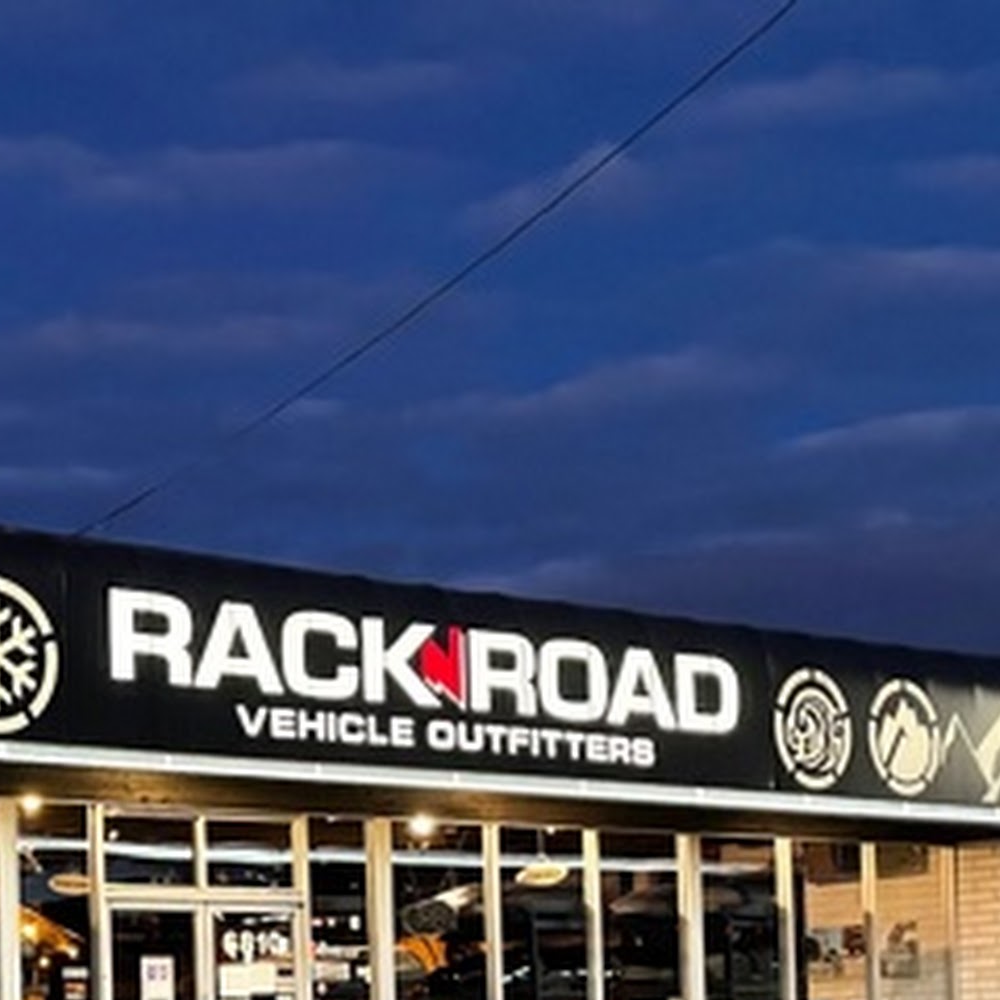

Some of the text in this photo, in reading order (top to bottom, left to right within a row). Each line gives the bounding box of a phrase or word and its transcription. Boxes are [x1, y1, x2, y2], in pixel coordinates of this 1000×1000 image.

[108, 586, 442, 707] RACK
[467, 627, 741, 735] ROAD
[236, 704, 656, 767] VEHICLE OUTFITTERS
